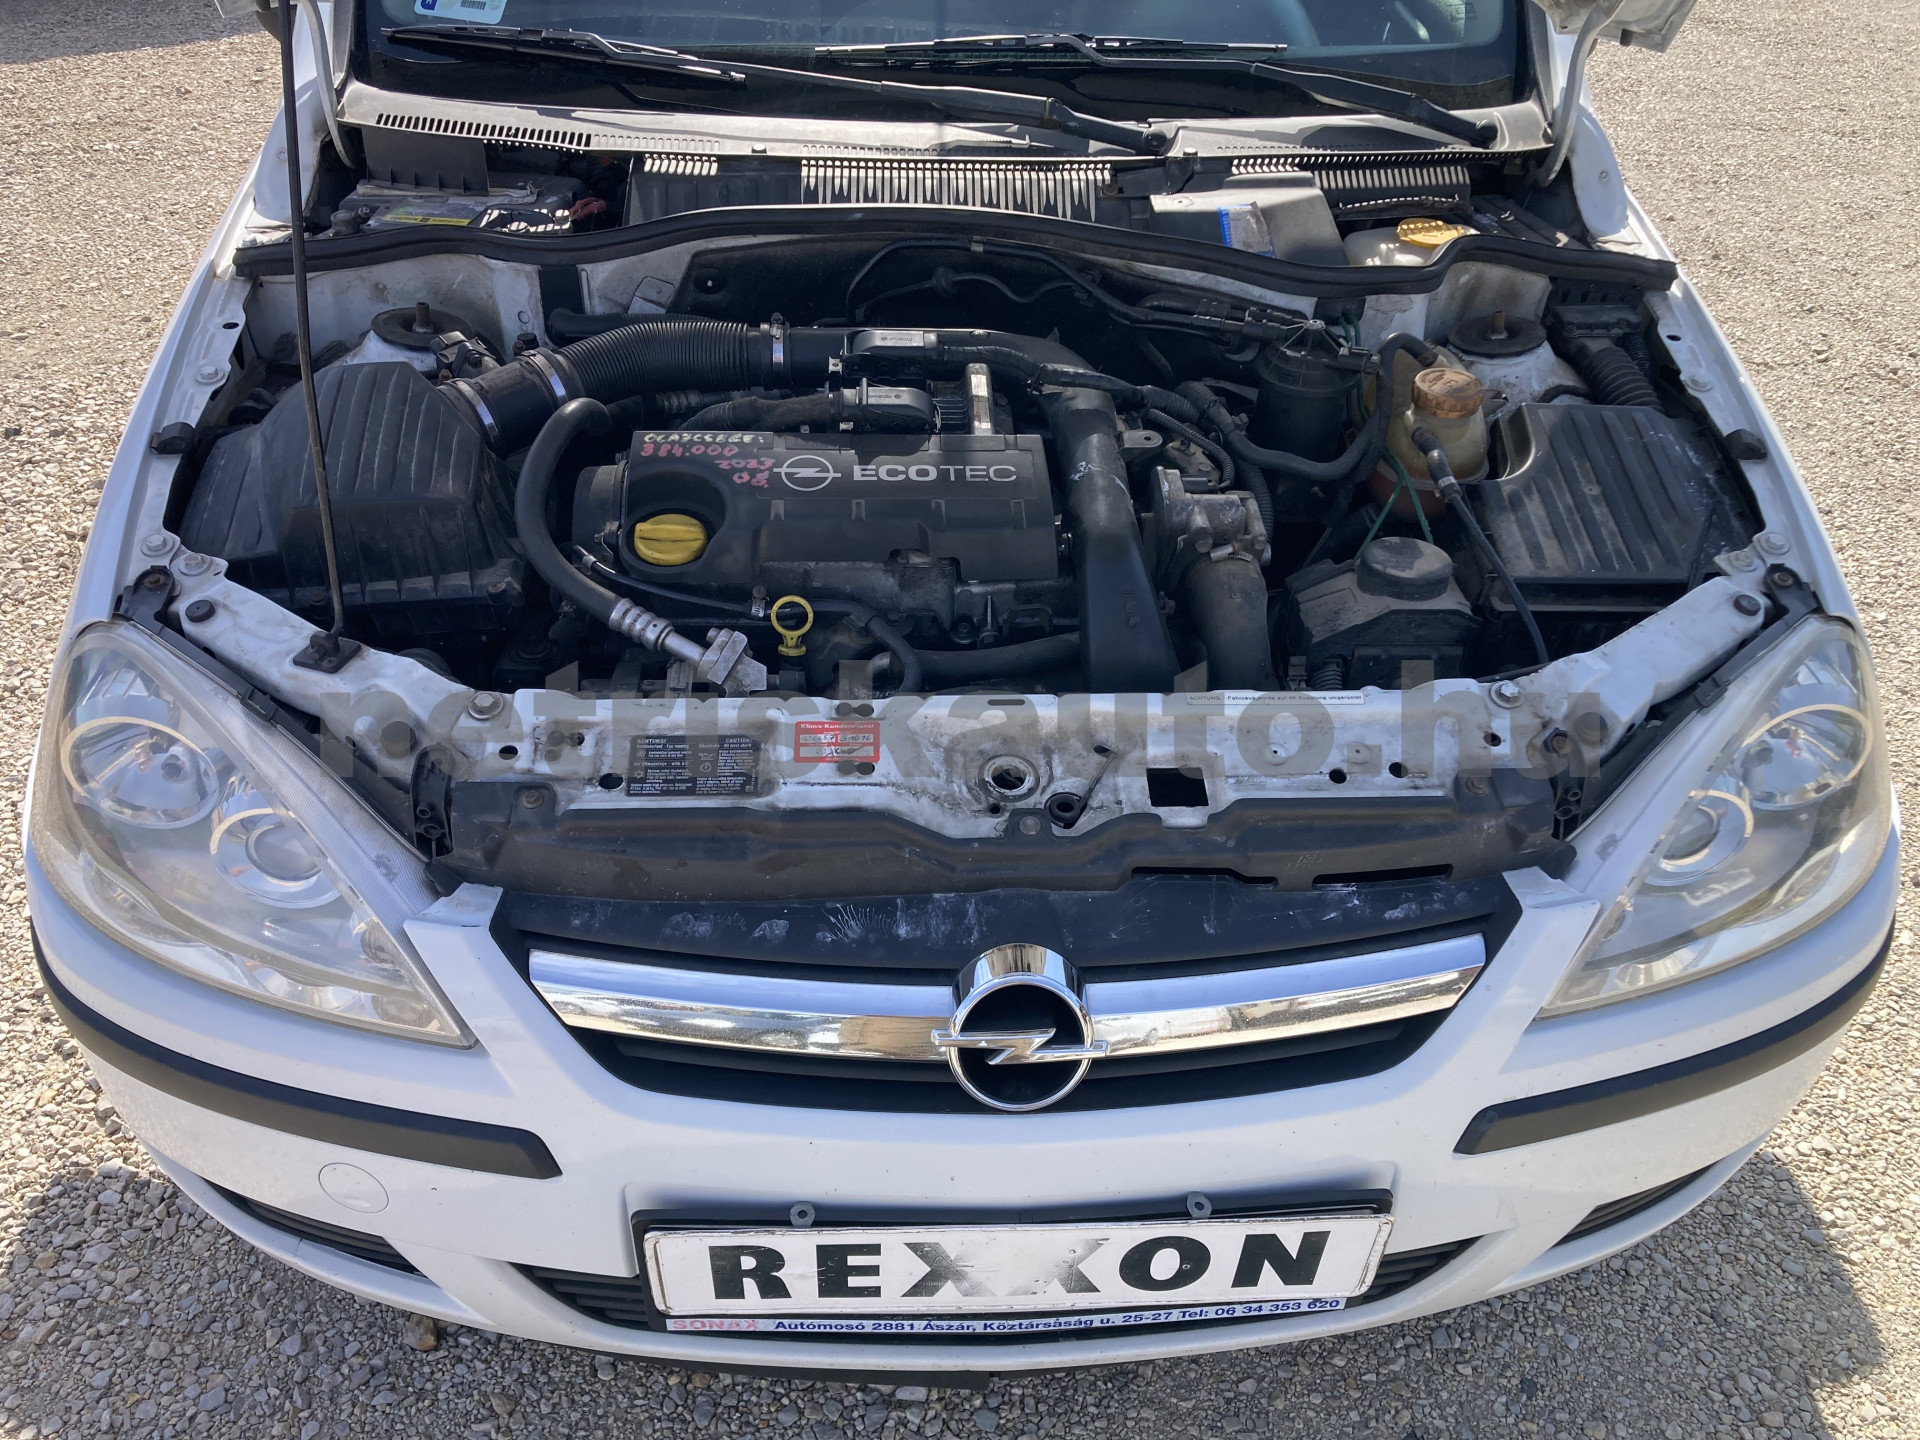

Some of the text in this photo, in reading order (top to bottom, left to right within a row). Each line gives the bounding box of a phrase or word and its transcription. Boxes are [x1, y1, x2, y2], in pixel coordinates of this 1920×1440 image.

[853, 465, 1017, 481] ECOTEC
[708, 1230, 1331, 1299] REXXON
[672, 1299, 1341, 1333] SONAX Autómosó 2881 Ászár, Köztársaság u. 25-27 Tel: 06 34 353 620
